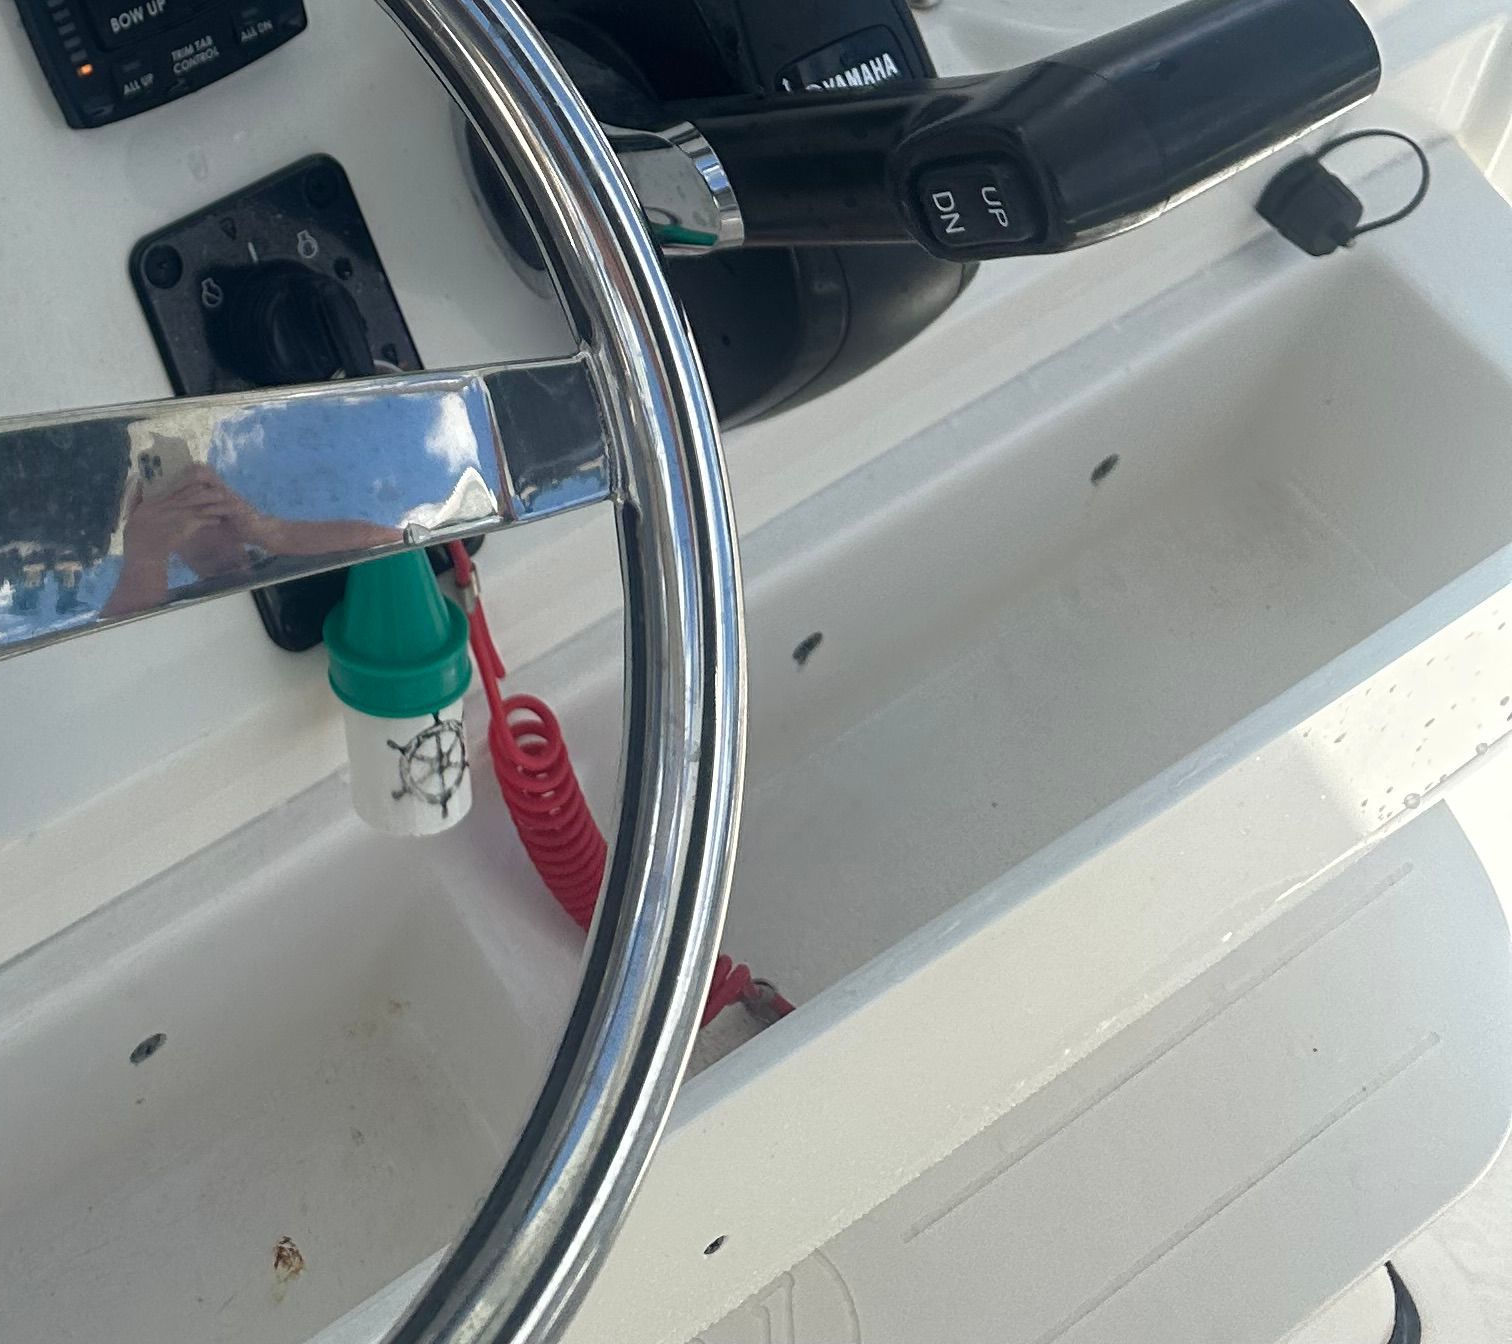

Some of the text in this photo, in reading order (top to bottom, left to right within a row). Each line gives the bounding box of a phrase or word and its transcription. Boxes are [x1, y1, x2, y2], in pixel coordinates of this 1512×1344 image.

[110, 5, 145, 34] BOW
[240, 27, 258, 42] ALL
[171, 44, 194, 62] TRIM
[173, 46, 220, 74] CONTROL
[123, 73, 154, 96] ALL UP
[932, 191, 966, 235] DN
[981, 186, 1009, 228] UP
